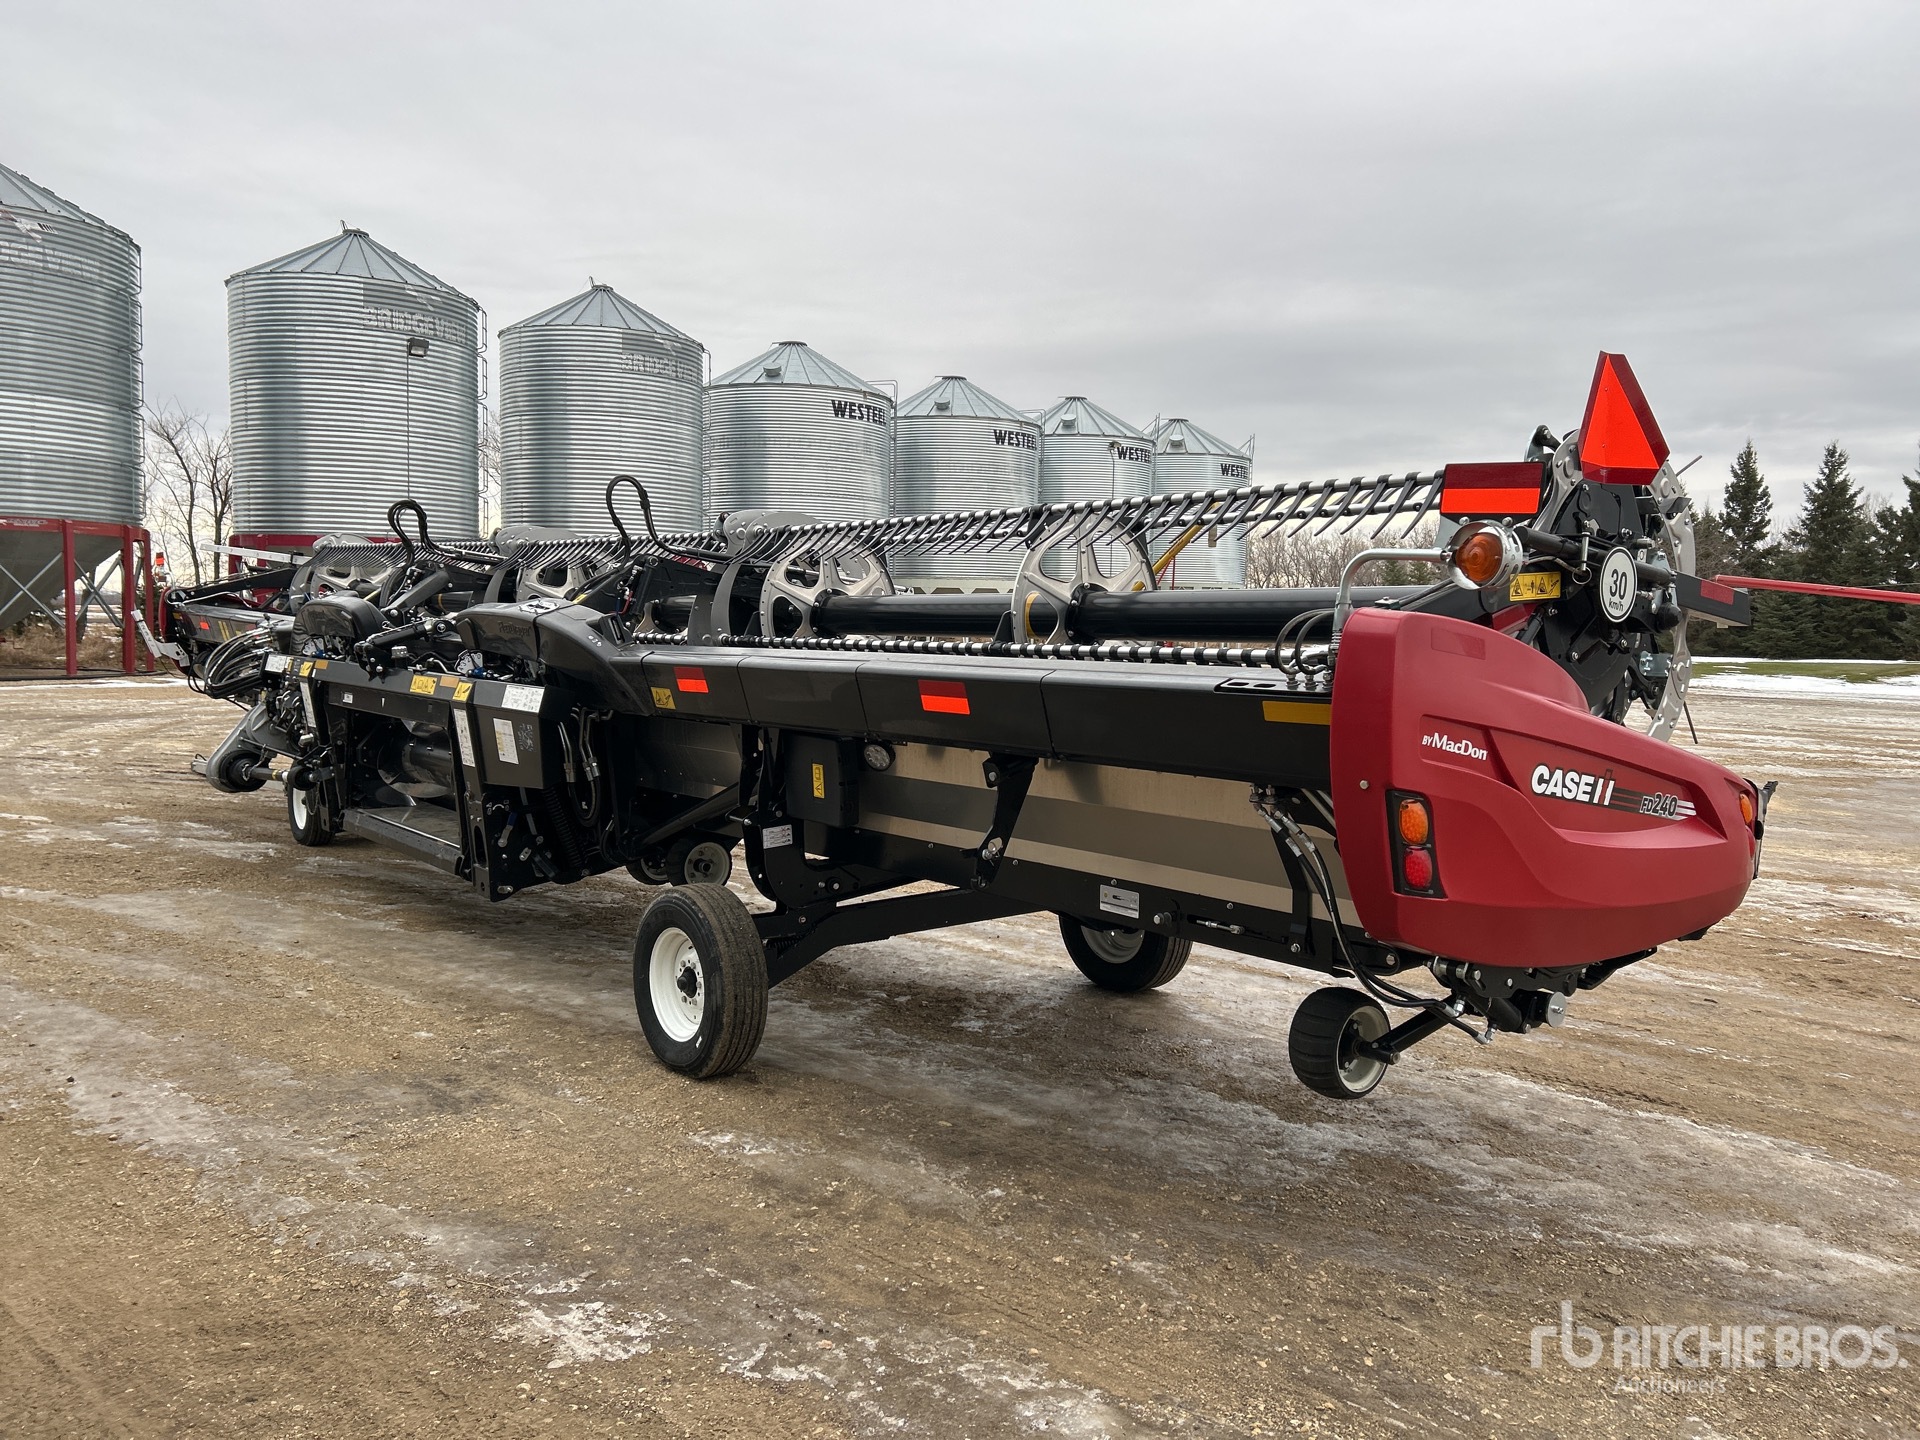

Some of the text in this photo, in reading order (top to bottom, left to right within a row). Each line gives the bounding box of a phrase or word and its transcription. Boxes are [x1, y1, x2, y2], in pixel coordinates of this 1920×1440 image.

[1609, 568, 1628, 600] 30
[1608, 597, 1624, 612] km/h
[1421, 732, 1488, 760] BY MacDon
[1531, 764, 1596, 803] CASE
[1640, 792, 1679, 819] FD240
